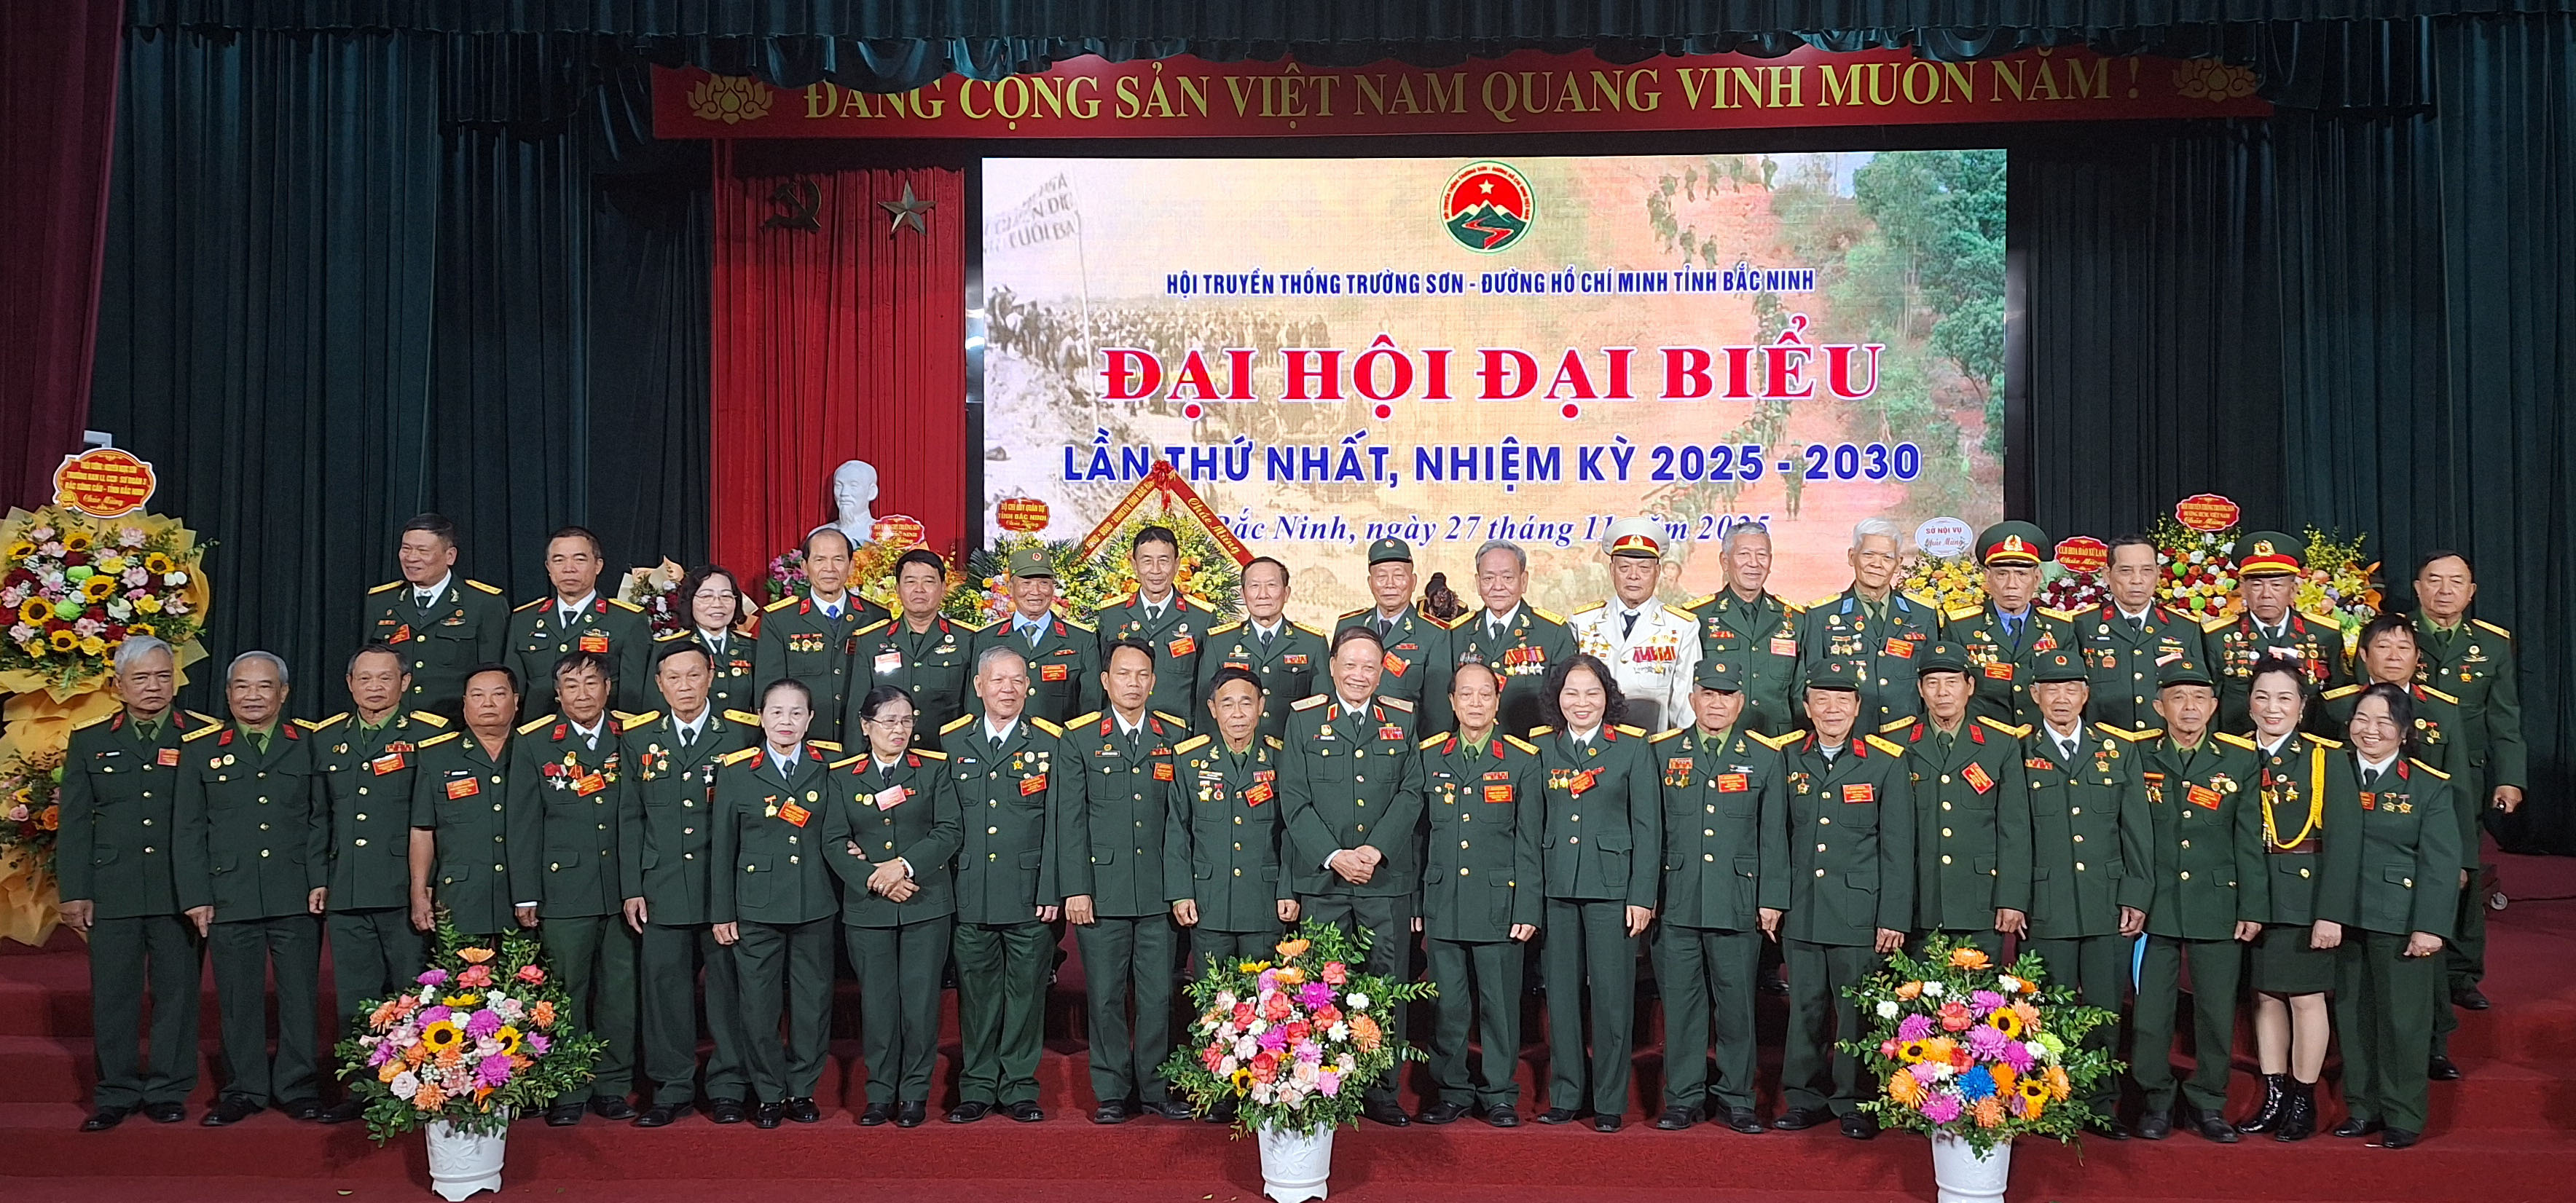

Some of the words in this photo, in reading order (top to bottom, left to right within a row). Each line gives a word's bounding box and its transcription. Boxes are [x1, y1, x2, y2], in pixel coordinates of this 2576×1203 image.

[1115, 62, 1210, 119] SẢN
[1223, 62, 1340, 129] VIỆT
[1353, 72, 1469, 116] NAM
[1482, 68, 1662, 123] QUANG
[1676, 66, 1805, 110] VINH
[1990, 47, 2111, 103] NĂM
[2127, 55, 2140, 99] !
[1167, 270, 1197, 298] HỘI
[1203, 267, 1274, 293] TRUYỀN
[1281, 267, 1340, 294] THỐNG
[1347, 271, 1419, 294] TRƯỜNG
[1426, 272, 1463, 293] SƠN
[1481, 270, 1545, 293] ĐƯỜNG
[1552, 265, 1575, 293] HỒ
[1582, 269, 1612, 293] CHÍ
[1619, 272, 1668, 293] MINH
[1674, 264, 1717, 291] TỈNH
[1724, 263, 1761, 291] BẮC
[1767, 270, 1813, 291] NINH
[1100, 350, 1257, 419] ĐẠI
[1281, 334, 1453, 419] HỘI
[1476, 349, 1635, 418] ĐẠI
[1661, 316, 1883, 398] BIỂU
[1064, 428, 1149, 481] LẦN
[1166, 435, 1253, 481] THỨ
[1267, 430, 1398, 488] NHẤT,
[1415, 437, 1560, 492] NHIỆM
[1579, 435, 1635, 481] KỲ
[1652, 445, 1763, 481] 2025
[1777, 462, 1791, 470] -
[1805, 443, 1920, 481] 2030
[1188, 497, 1212, 524] Chúc
[1209, 524, 1241, 554] Mừng
[1273, 516, 1355, 545] Ninh,
[1366, 516, 1437, 546] ngày
[1445, 516, 1482, 539] 27
[1488, 515, 1574, 546] tháng
[1925, 525, 1936, 535] SỞ
[1938, 526, 1950, 535] NỘI
[1952, 526, 1962, 535] VỤ
